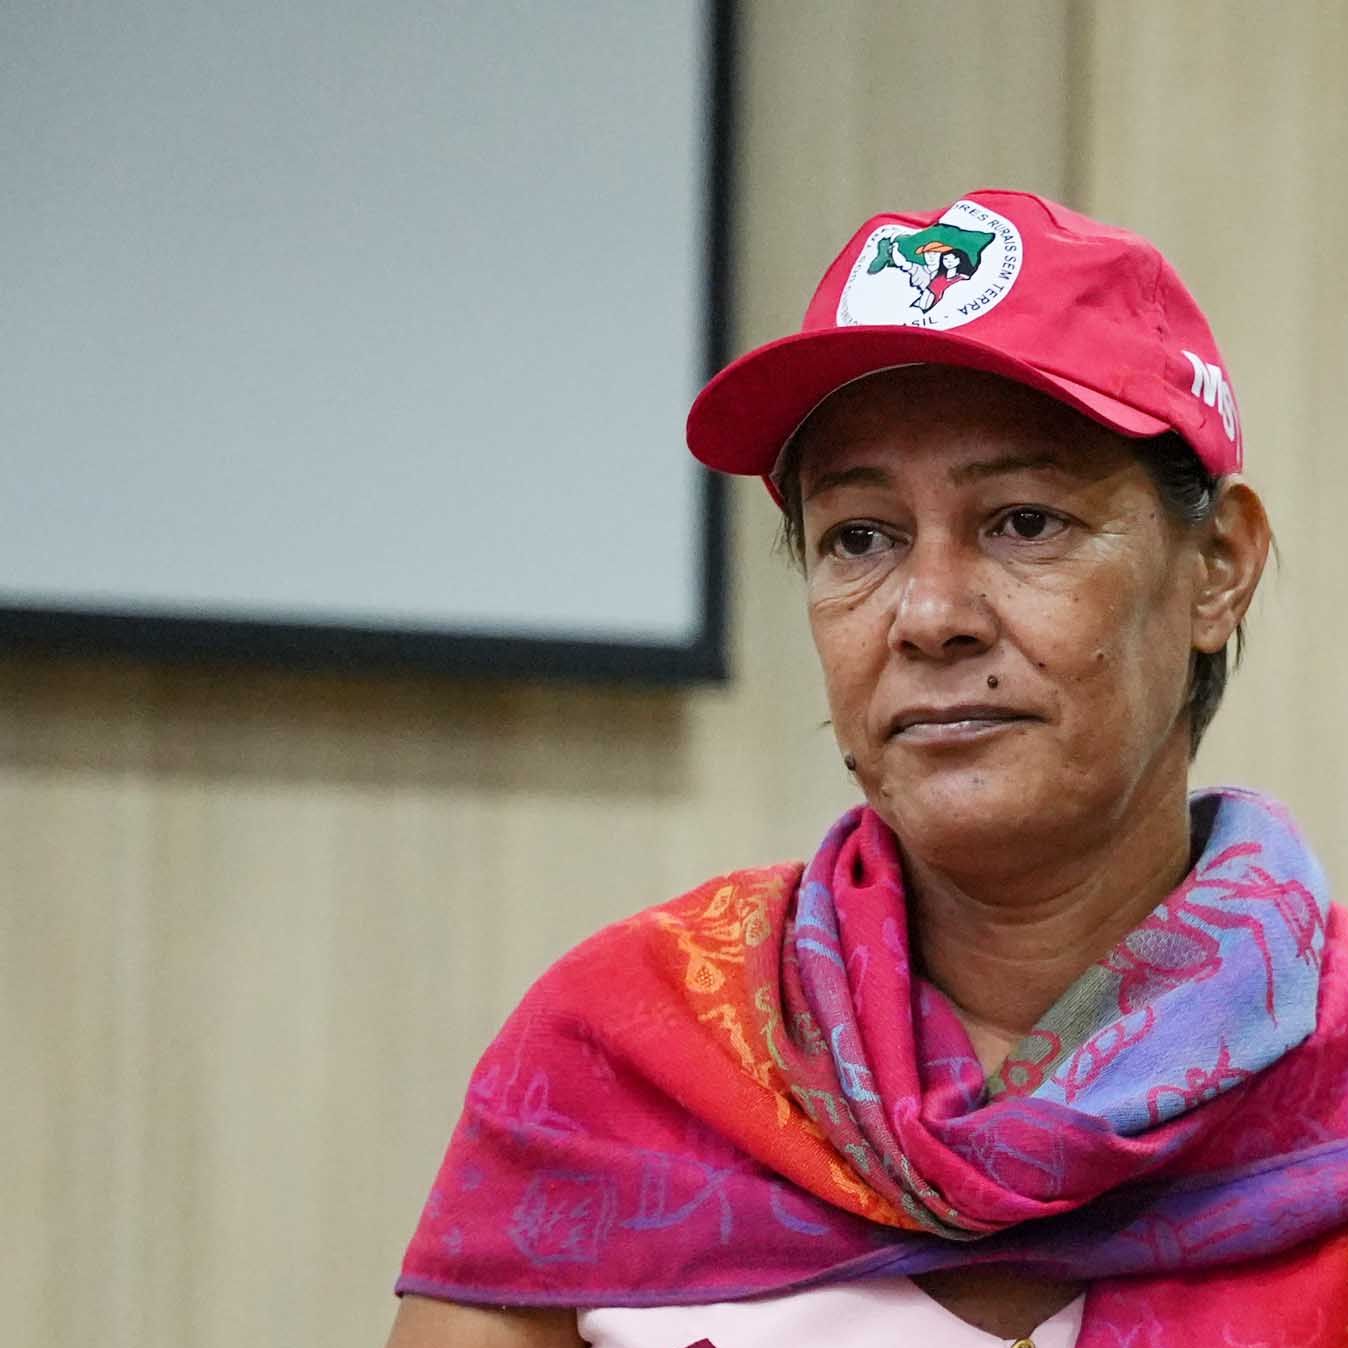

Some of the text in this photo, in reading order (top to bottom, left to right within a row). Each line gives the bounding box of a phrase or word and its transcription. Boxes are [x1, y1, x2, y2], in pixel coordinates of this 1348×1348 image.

[987, 218, 1017, 253] RURAIS
[1000, 254, 1017, 281] SEM
[958, 283, 1006, 317] TERRA
